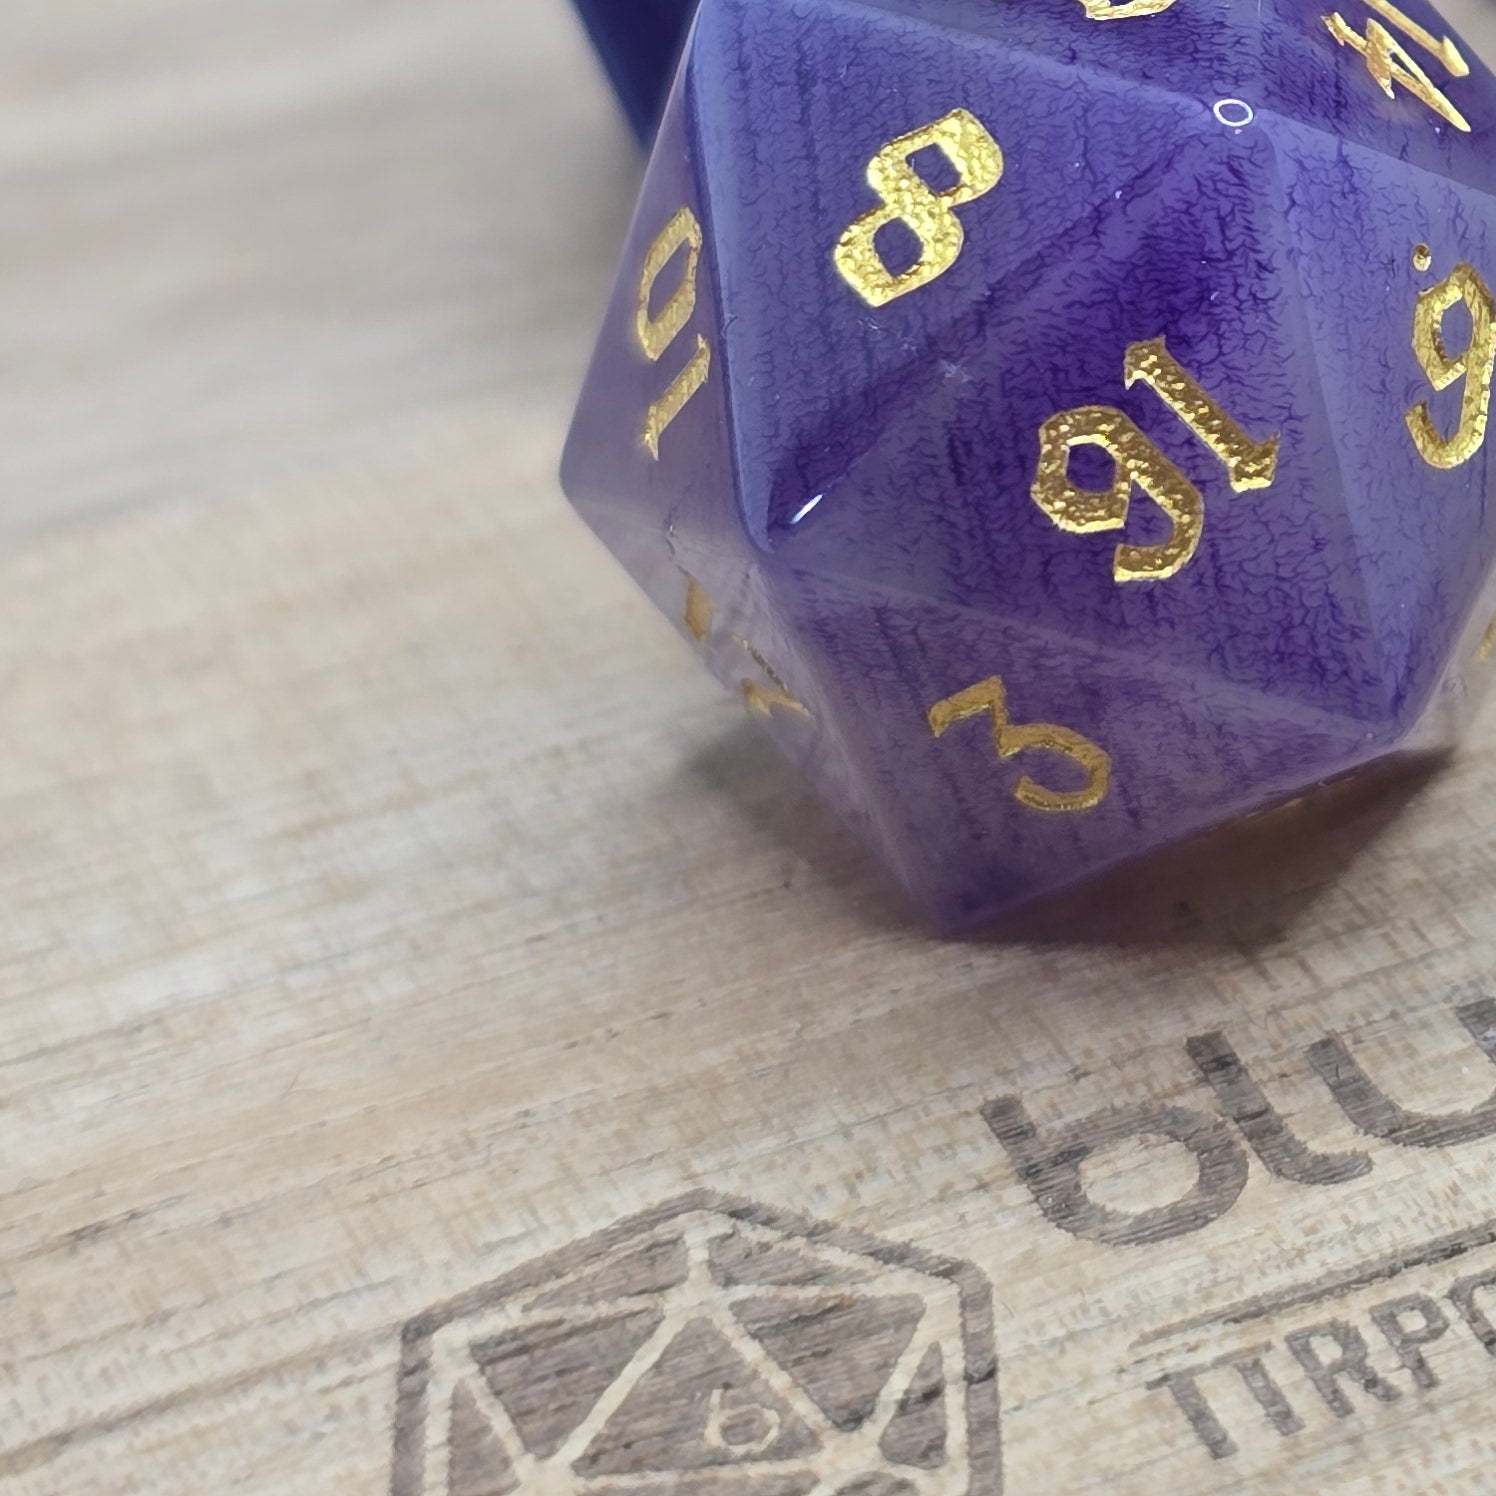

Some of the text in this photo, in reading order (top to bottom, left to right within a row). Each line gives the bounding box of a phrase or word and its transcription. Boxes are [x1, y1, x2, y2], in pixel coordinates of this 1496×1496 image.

[833, 107, 1004, 308] 8
[635, 206, 712, 462] 10
[928, 674, 1112, 814] 3
